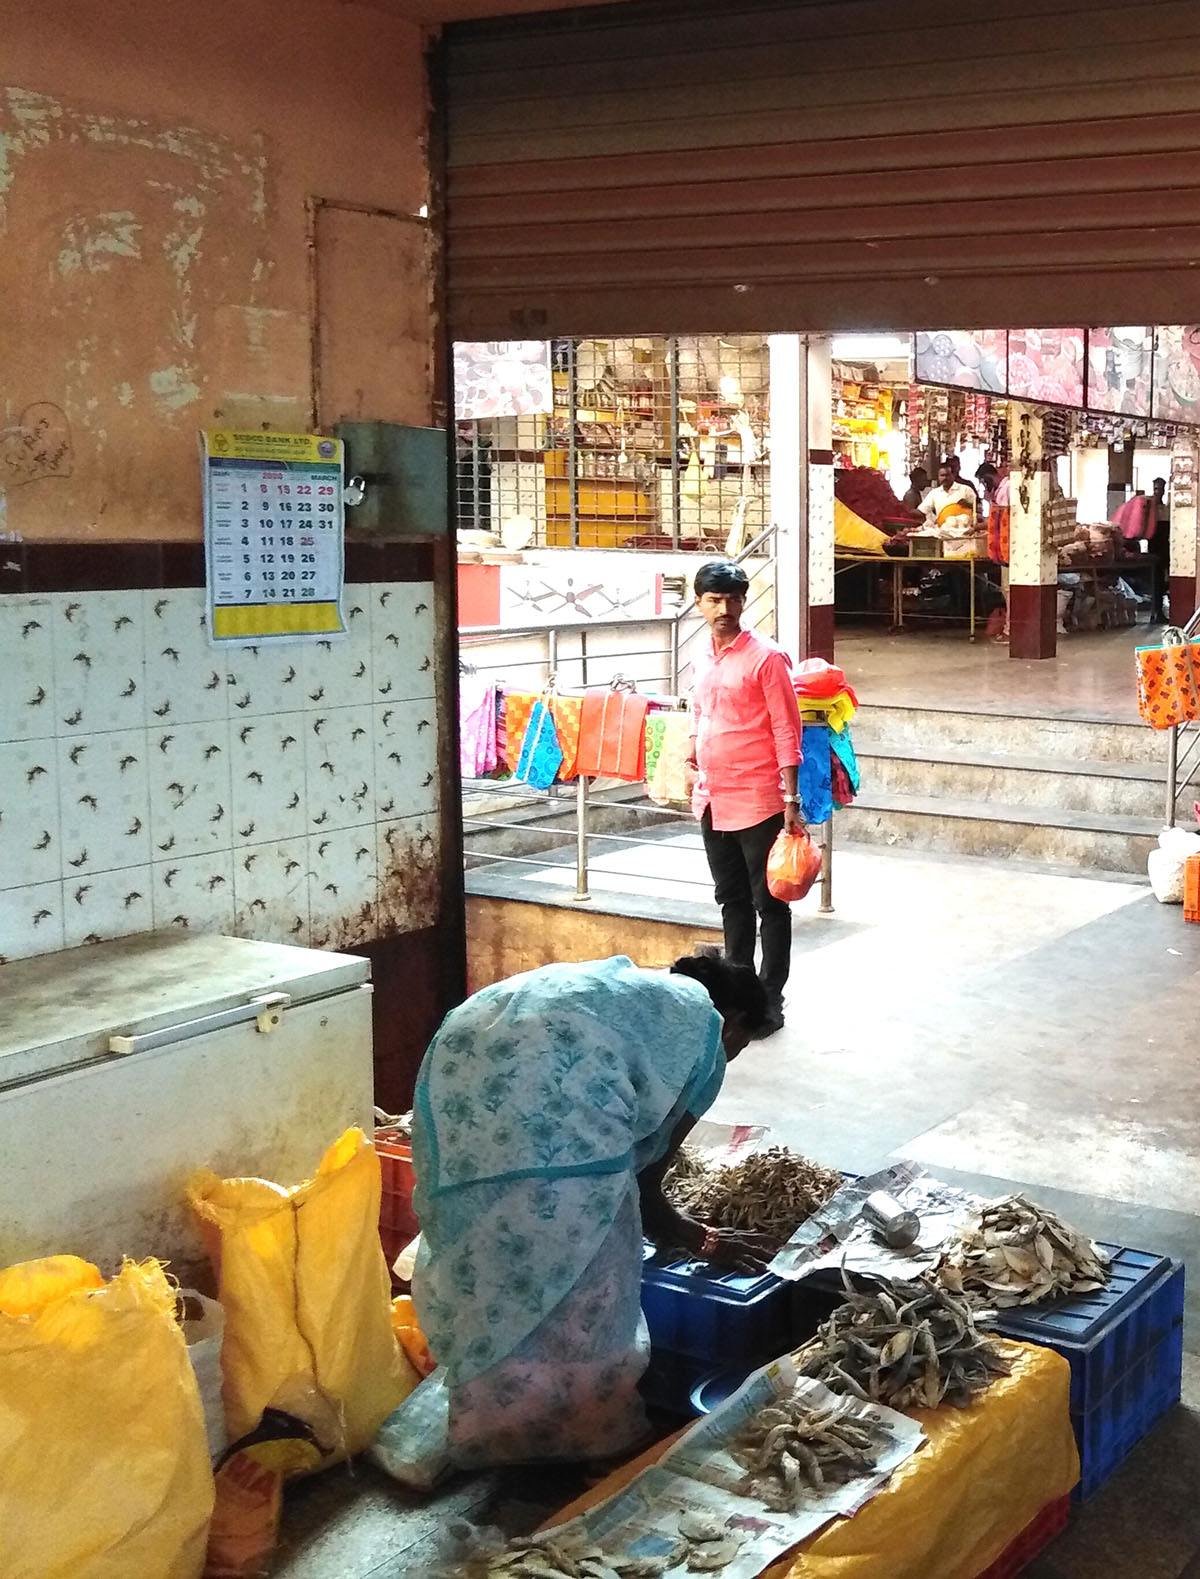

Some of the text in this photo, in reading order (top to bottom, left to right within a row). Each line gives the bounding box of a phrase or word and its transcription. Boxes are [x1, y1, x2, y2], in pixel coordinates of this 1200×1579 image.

[241, 484, 247, 493] 1
[260, 484, 267, 494] 8
[277, 485, 290, 495] 15
[297, 485, 312, 495] 22
[318, 486, 334, 495] 29
[241, 501, 249, 511] 2
[262, 501, 269, 511] 9
[279, 502, 292, 512] 16
[297, 502, 312, 512] 23
[318, 503, 334, 513] 30
[241, 519, 249, 528] 3
[259, 519, 273, 529] 10
[280, 519, 293, 529] 17
[299, 520, 313, 529] 24
[319, 520, 334, 530] 31
[241, 536, 249, 546] 4
[261, 536, 274, 546] 11
[280, 536, 294, 546] 18
[300, 536, 315, 546] 25
[243, 554, 250, 563] 5
[260, 554, 275, 564] 12
[281, 554, 295, 563] 19
[301, 554, 315, 563] 26
[244, 571, 316, 581] 6 13 20 27
[244, 589, 252, 599] 7
[262, 588, 276, 598] 14
[282, 588, 295, 597] 21
[301, 587, 315, 597] 28
